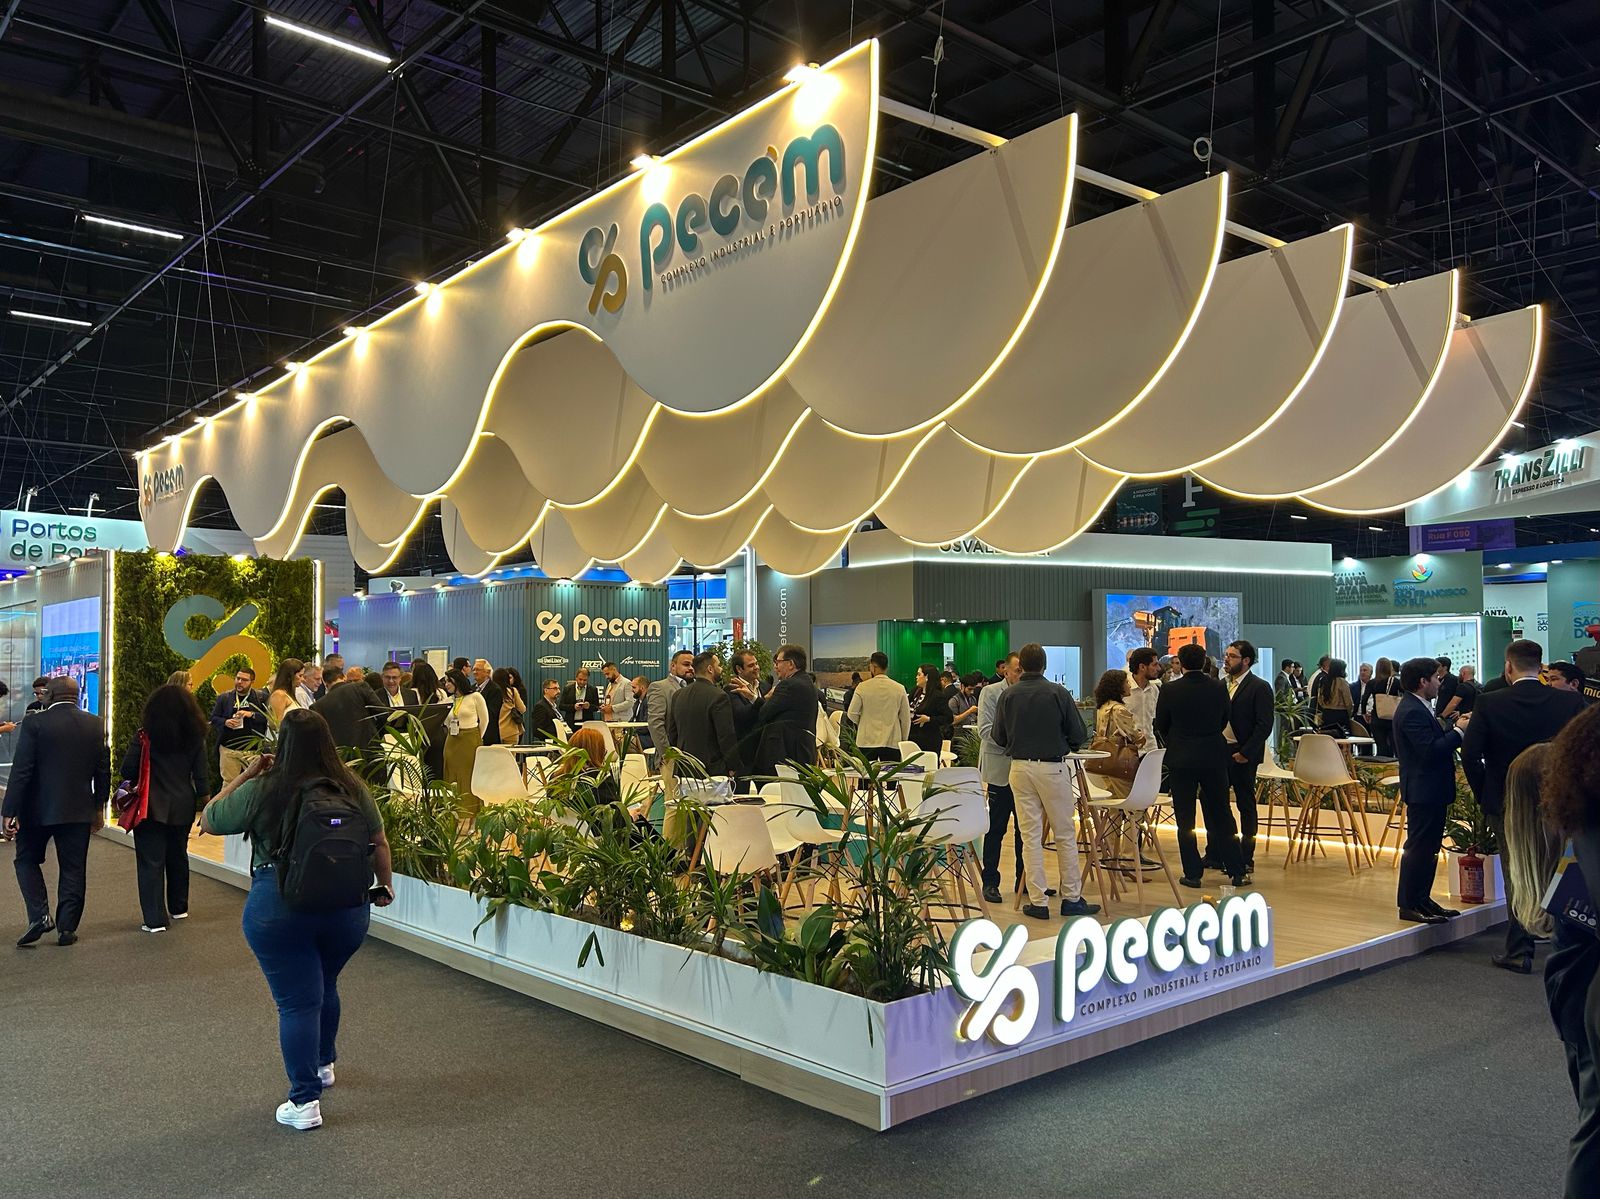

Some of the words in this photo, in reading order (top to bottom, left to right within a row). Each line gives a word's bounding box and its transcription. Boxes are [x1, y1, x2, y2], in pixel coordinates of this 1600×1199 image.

[660, 257, 706, 285] COMPLEXO
[709, 232, 766, 263] INDUSTRIAL
[769, 224, 777, 236] E
[778, 196, 842, 231] PORTUÁRIO
[1512, 485, 1535, 495] EXPRESSO
[12, 519, 97, 541] Portos
[11, 540, 43, 559] de
[668, 599, 702, 611] AIKIN
[1080, 991, 1137, 1016] COMPLEXO
[1143, 974, 1200, 999] INDUSTRIAL
[1203, 971, 1209, 982] E
